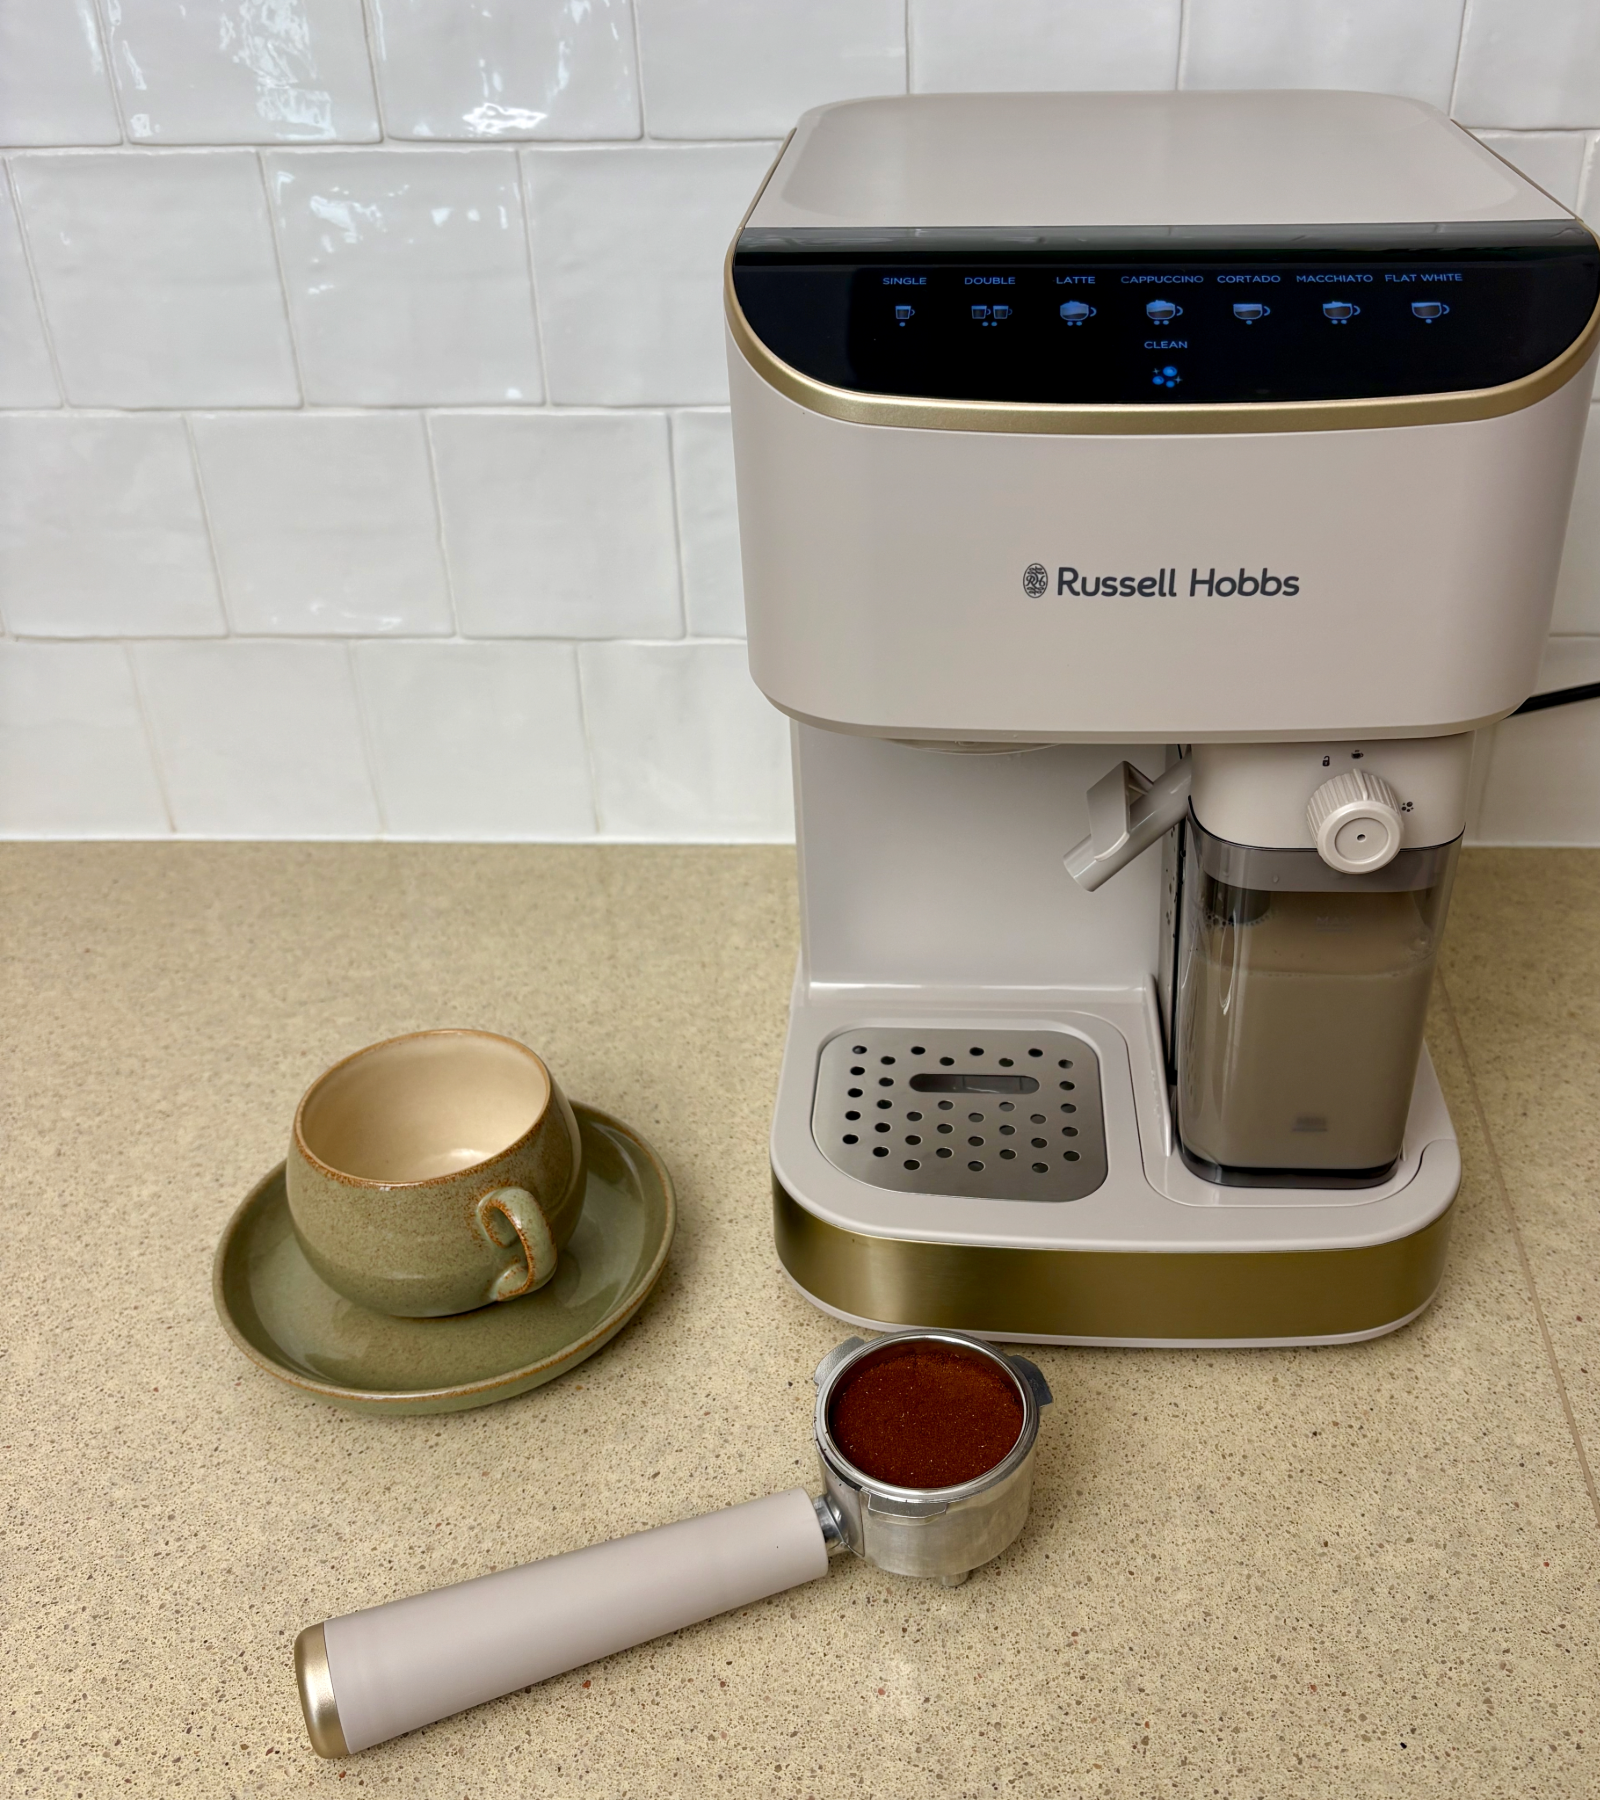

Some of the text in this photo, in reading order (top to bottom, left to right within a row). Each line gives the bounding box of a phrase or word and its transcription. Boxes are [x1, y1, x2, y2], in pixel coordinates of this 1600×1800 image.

[882, 276, 927, 285] SINGLE
[964, 276, 1016, 285] DOUBLE
[1056, 276, 1096, 285] LATTE
[1120, 275, 1204, 285] CAPPUCCINO
[1216, 274, 1281, 284] CORTADO
[1296, 274, 1374, 283] MACCHIATO
[1384, 273, 1463, 283] FLAT WHITE
[1143, 340, 1188, 350] CLEAN
[1057, 566, 1300, 598] Russell Hobbs
